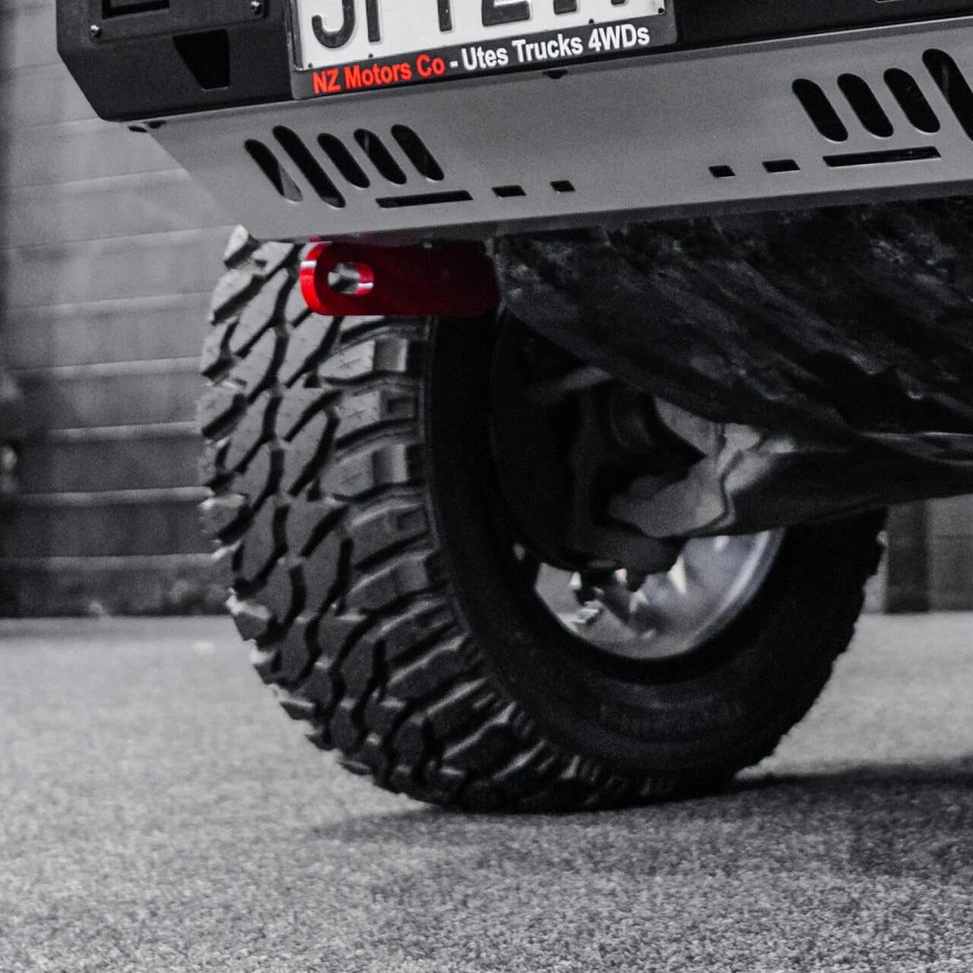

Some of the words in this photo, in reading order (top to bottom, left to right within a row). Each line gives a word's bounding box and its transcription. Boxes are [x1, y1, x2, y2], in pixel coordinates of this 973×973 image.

[312, 70, 340, 94] NZ
[344, 60, 412, 88] Motors
[416, 53, 445, 76] Co
[461, 46, 508, 71] Utes
[511, 33, 583, 61] Trucks
[588, 23, 651, 52] 4WDs
